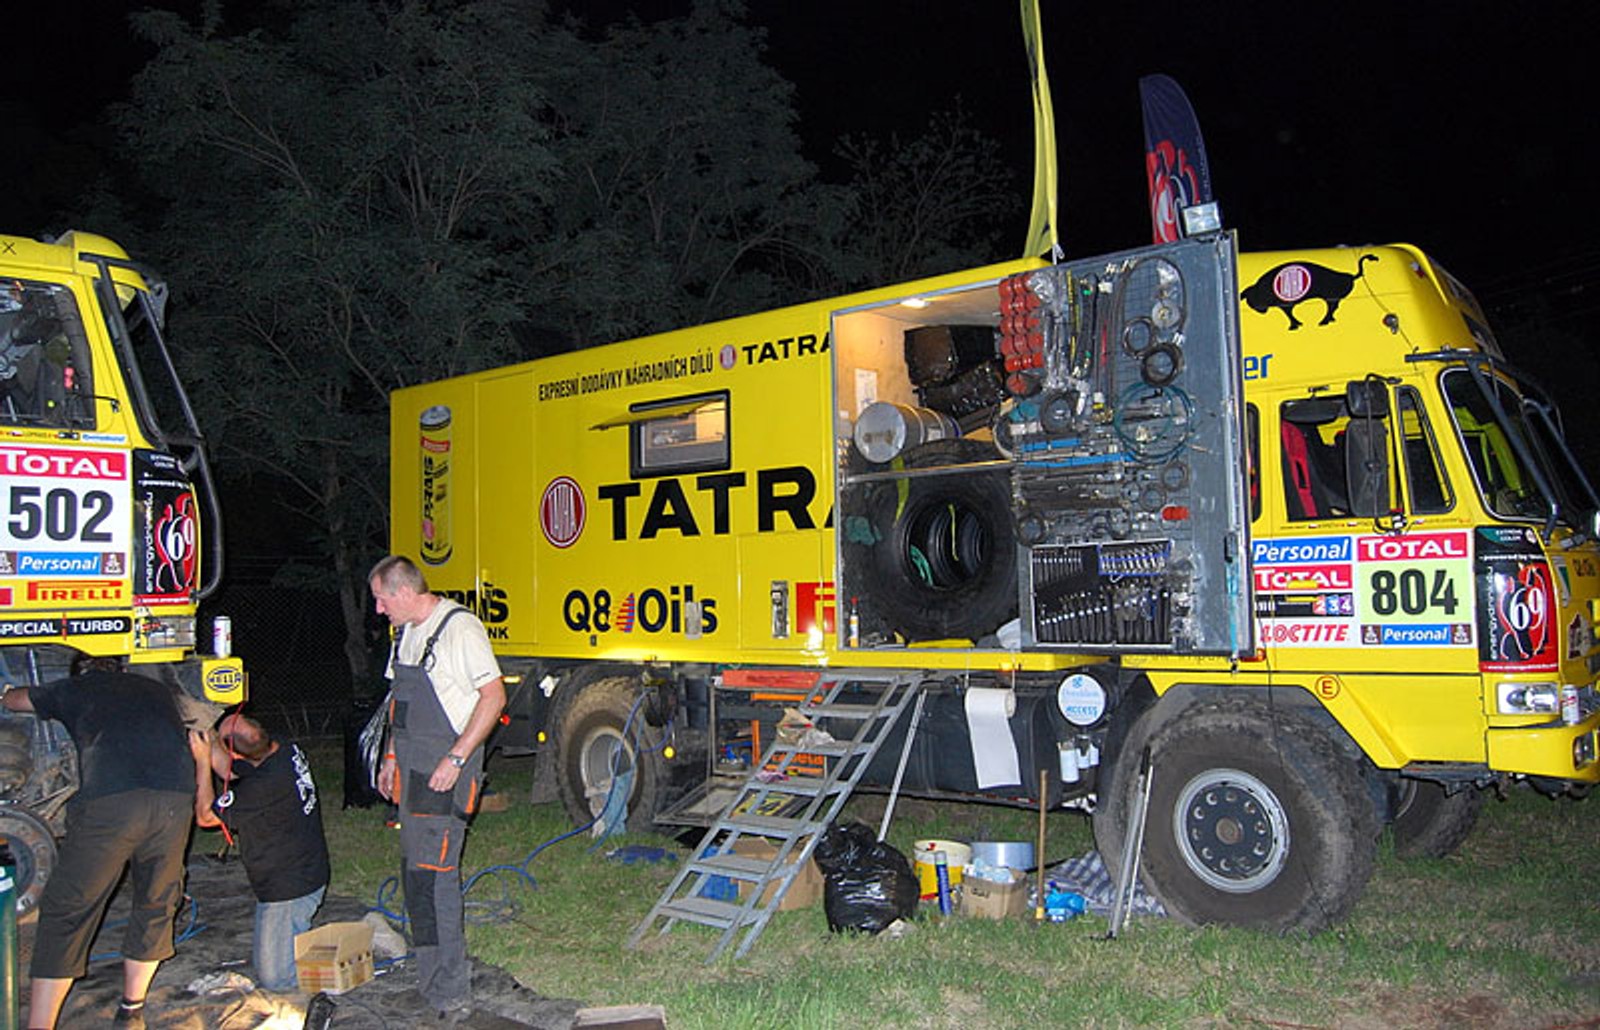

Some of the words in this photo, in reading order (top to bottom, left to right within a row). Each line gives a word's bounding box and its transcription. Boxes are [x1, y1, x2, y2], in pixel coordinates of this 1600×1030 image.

[581, 367, 624, 395] DODÁVKY
[625, 353, 688, 387] NÁHRADNÍCH
[0, 450, 122, 477] TOTAL
[8, 486, 113, 542] 502
[598, 466, 835, 541] TATR
[1254, 538, 1349, 561] Personal
[1360, 538, 1465, 559] TOTAL
[20, 555, 98, 571] Personal
[26, 580, 123, 601] PIRELLI
[1371, 568, 1459, 616] 804
[563, 588, 611, 634] Q8
[70, 620, 124, 632] TURBO
[1260, 624, 1349, 642] LOCTITE
[1383, 627, 1447, 641] Personal
[1321, 680, 1334, 695] E
